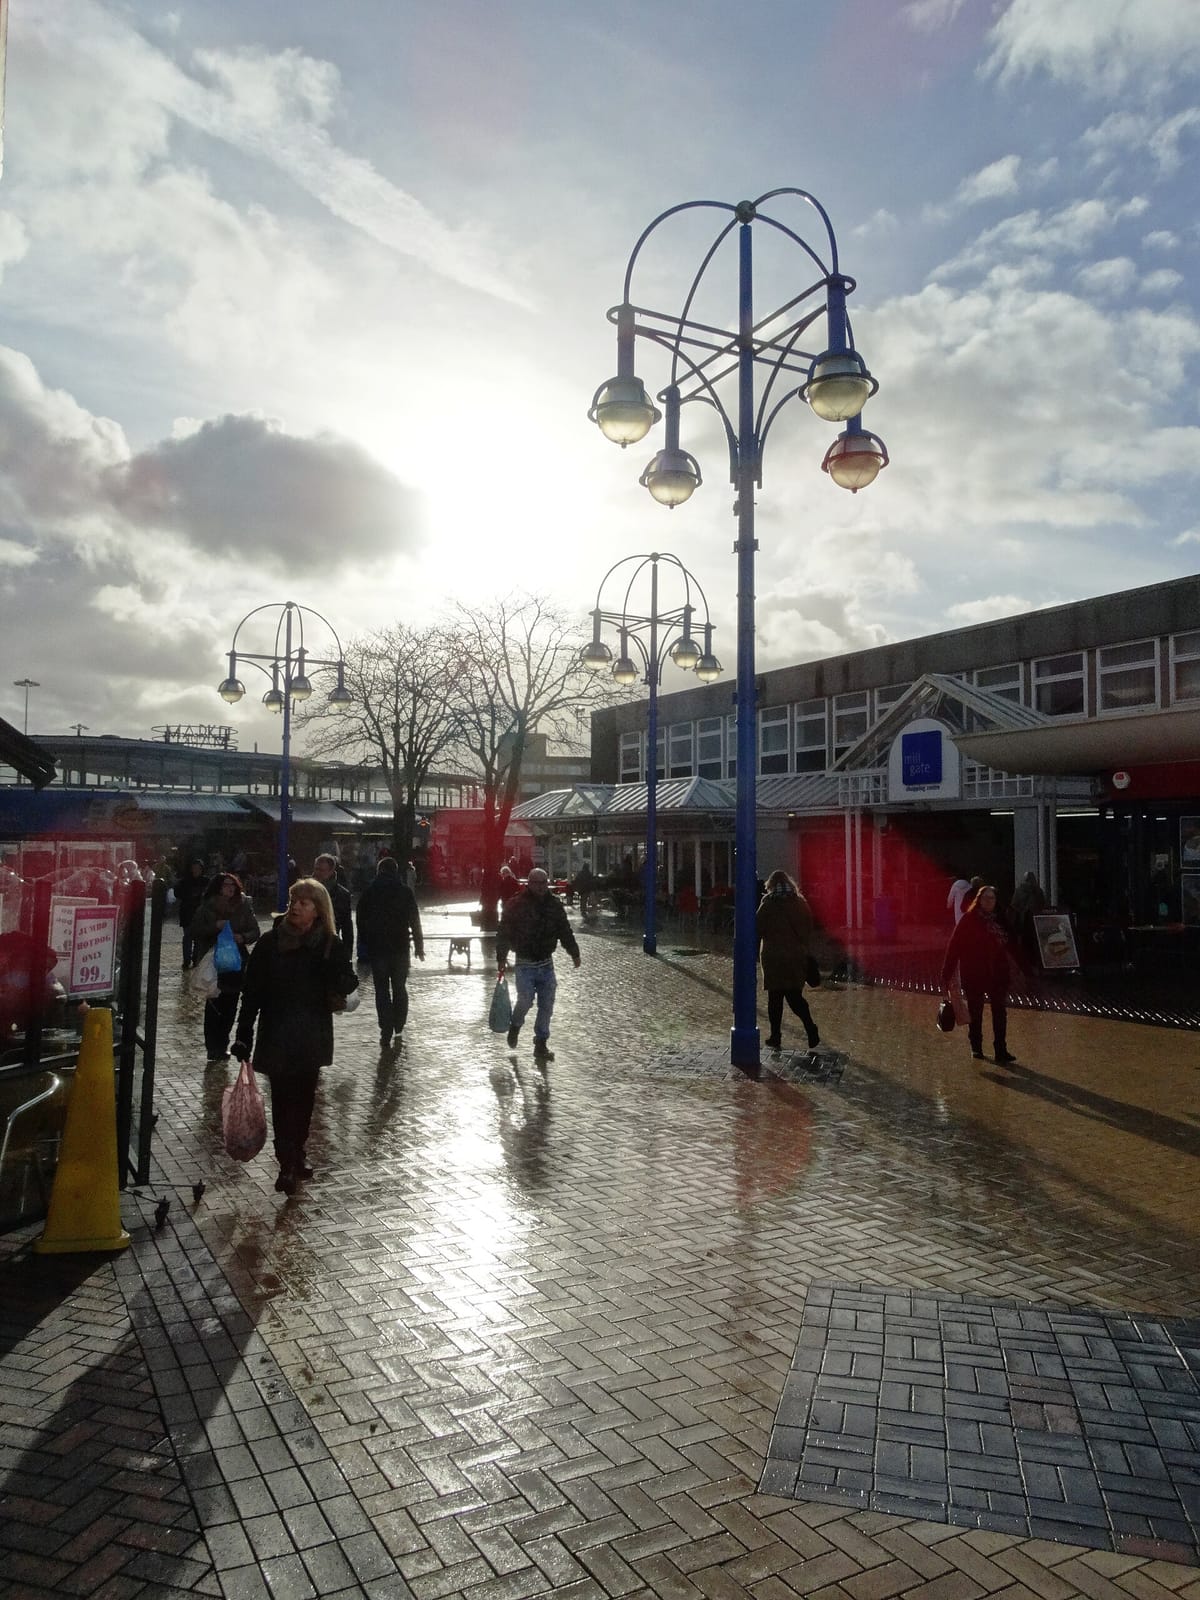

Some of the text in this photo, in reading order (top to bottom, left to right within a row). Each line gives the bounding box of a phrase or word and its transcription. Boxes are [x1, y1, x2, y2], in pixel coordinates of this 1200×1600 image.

[904, 752, 920, 764] mill
[909, 763, 930, 776] gate
[78, 922, 108, 935] JUMBO
[77, 936, 111, 950] HOTDOG
[82, 951, 102, 962] ONLY
